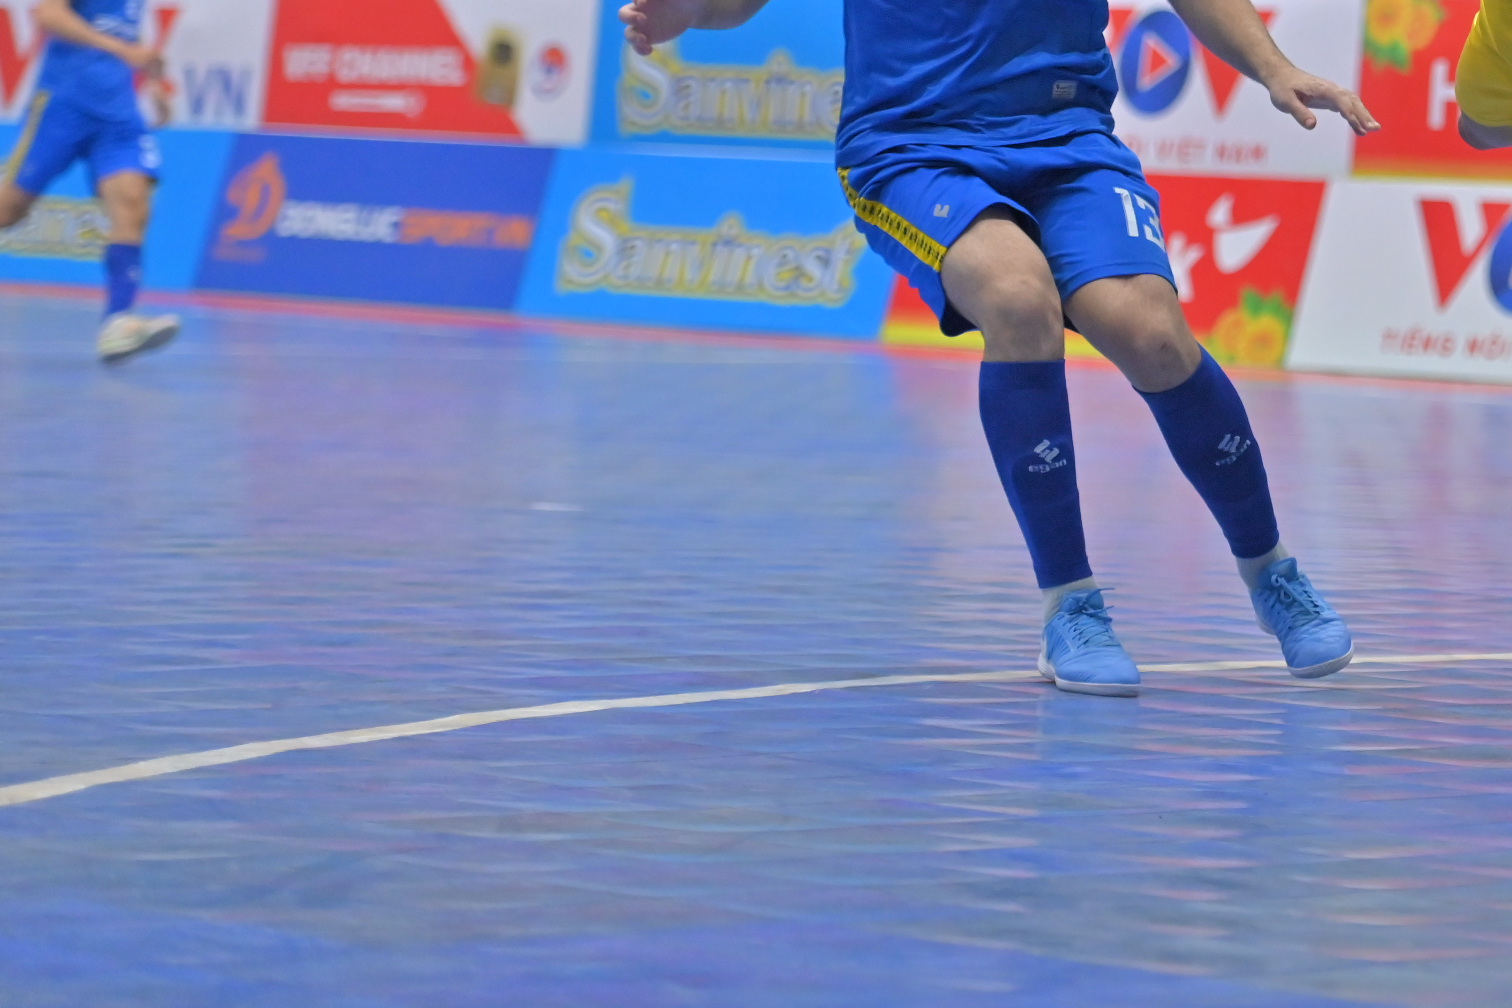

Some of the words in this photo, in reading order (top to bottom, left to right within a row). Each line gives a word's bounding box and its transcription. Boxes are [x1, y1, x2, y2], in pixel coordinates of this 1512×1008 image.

[617, 42, 844, 138] Sanvine
[557, 182, 864, 307] Sanvinest
[1112, 186, 1167, 253] 13
[1028, 458, 1067, 474] egan
